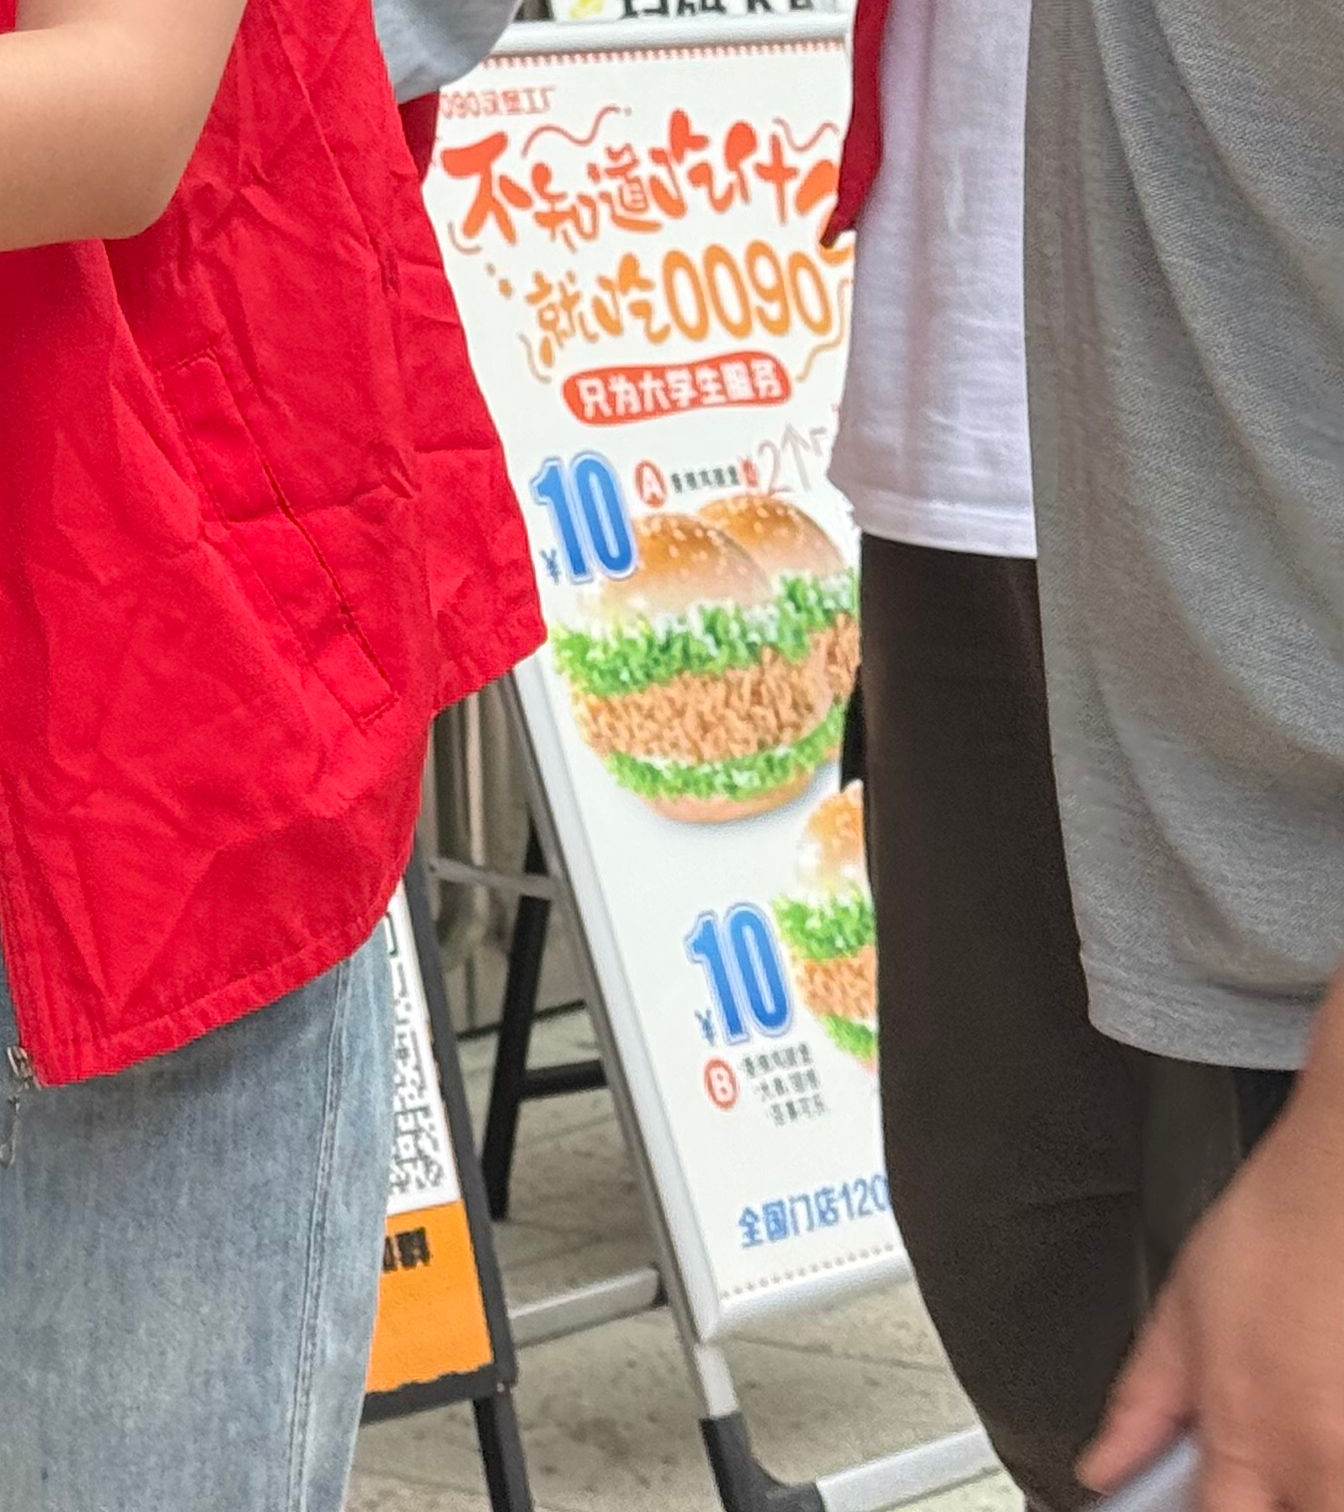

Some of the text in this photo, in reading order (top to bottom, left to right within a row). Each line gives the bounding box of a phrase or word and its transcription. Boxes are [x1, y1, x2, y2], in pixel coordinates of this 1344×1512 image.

[526, 241, 832, 368] 就吃0090
[576, 358, 783, 420] 只为大学生服务
